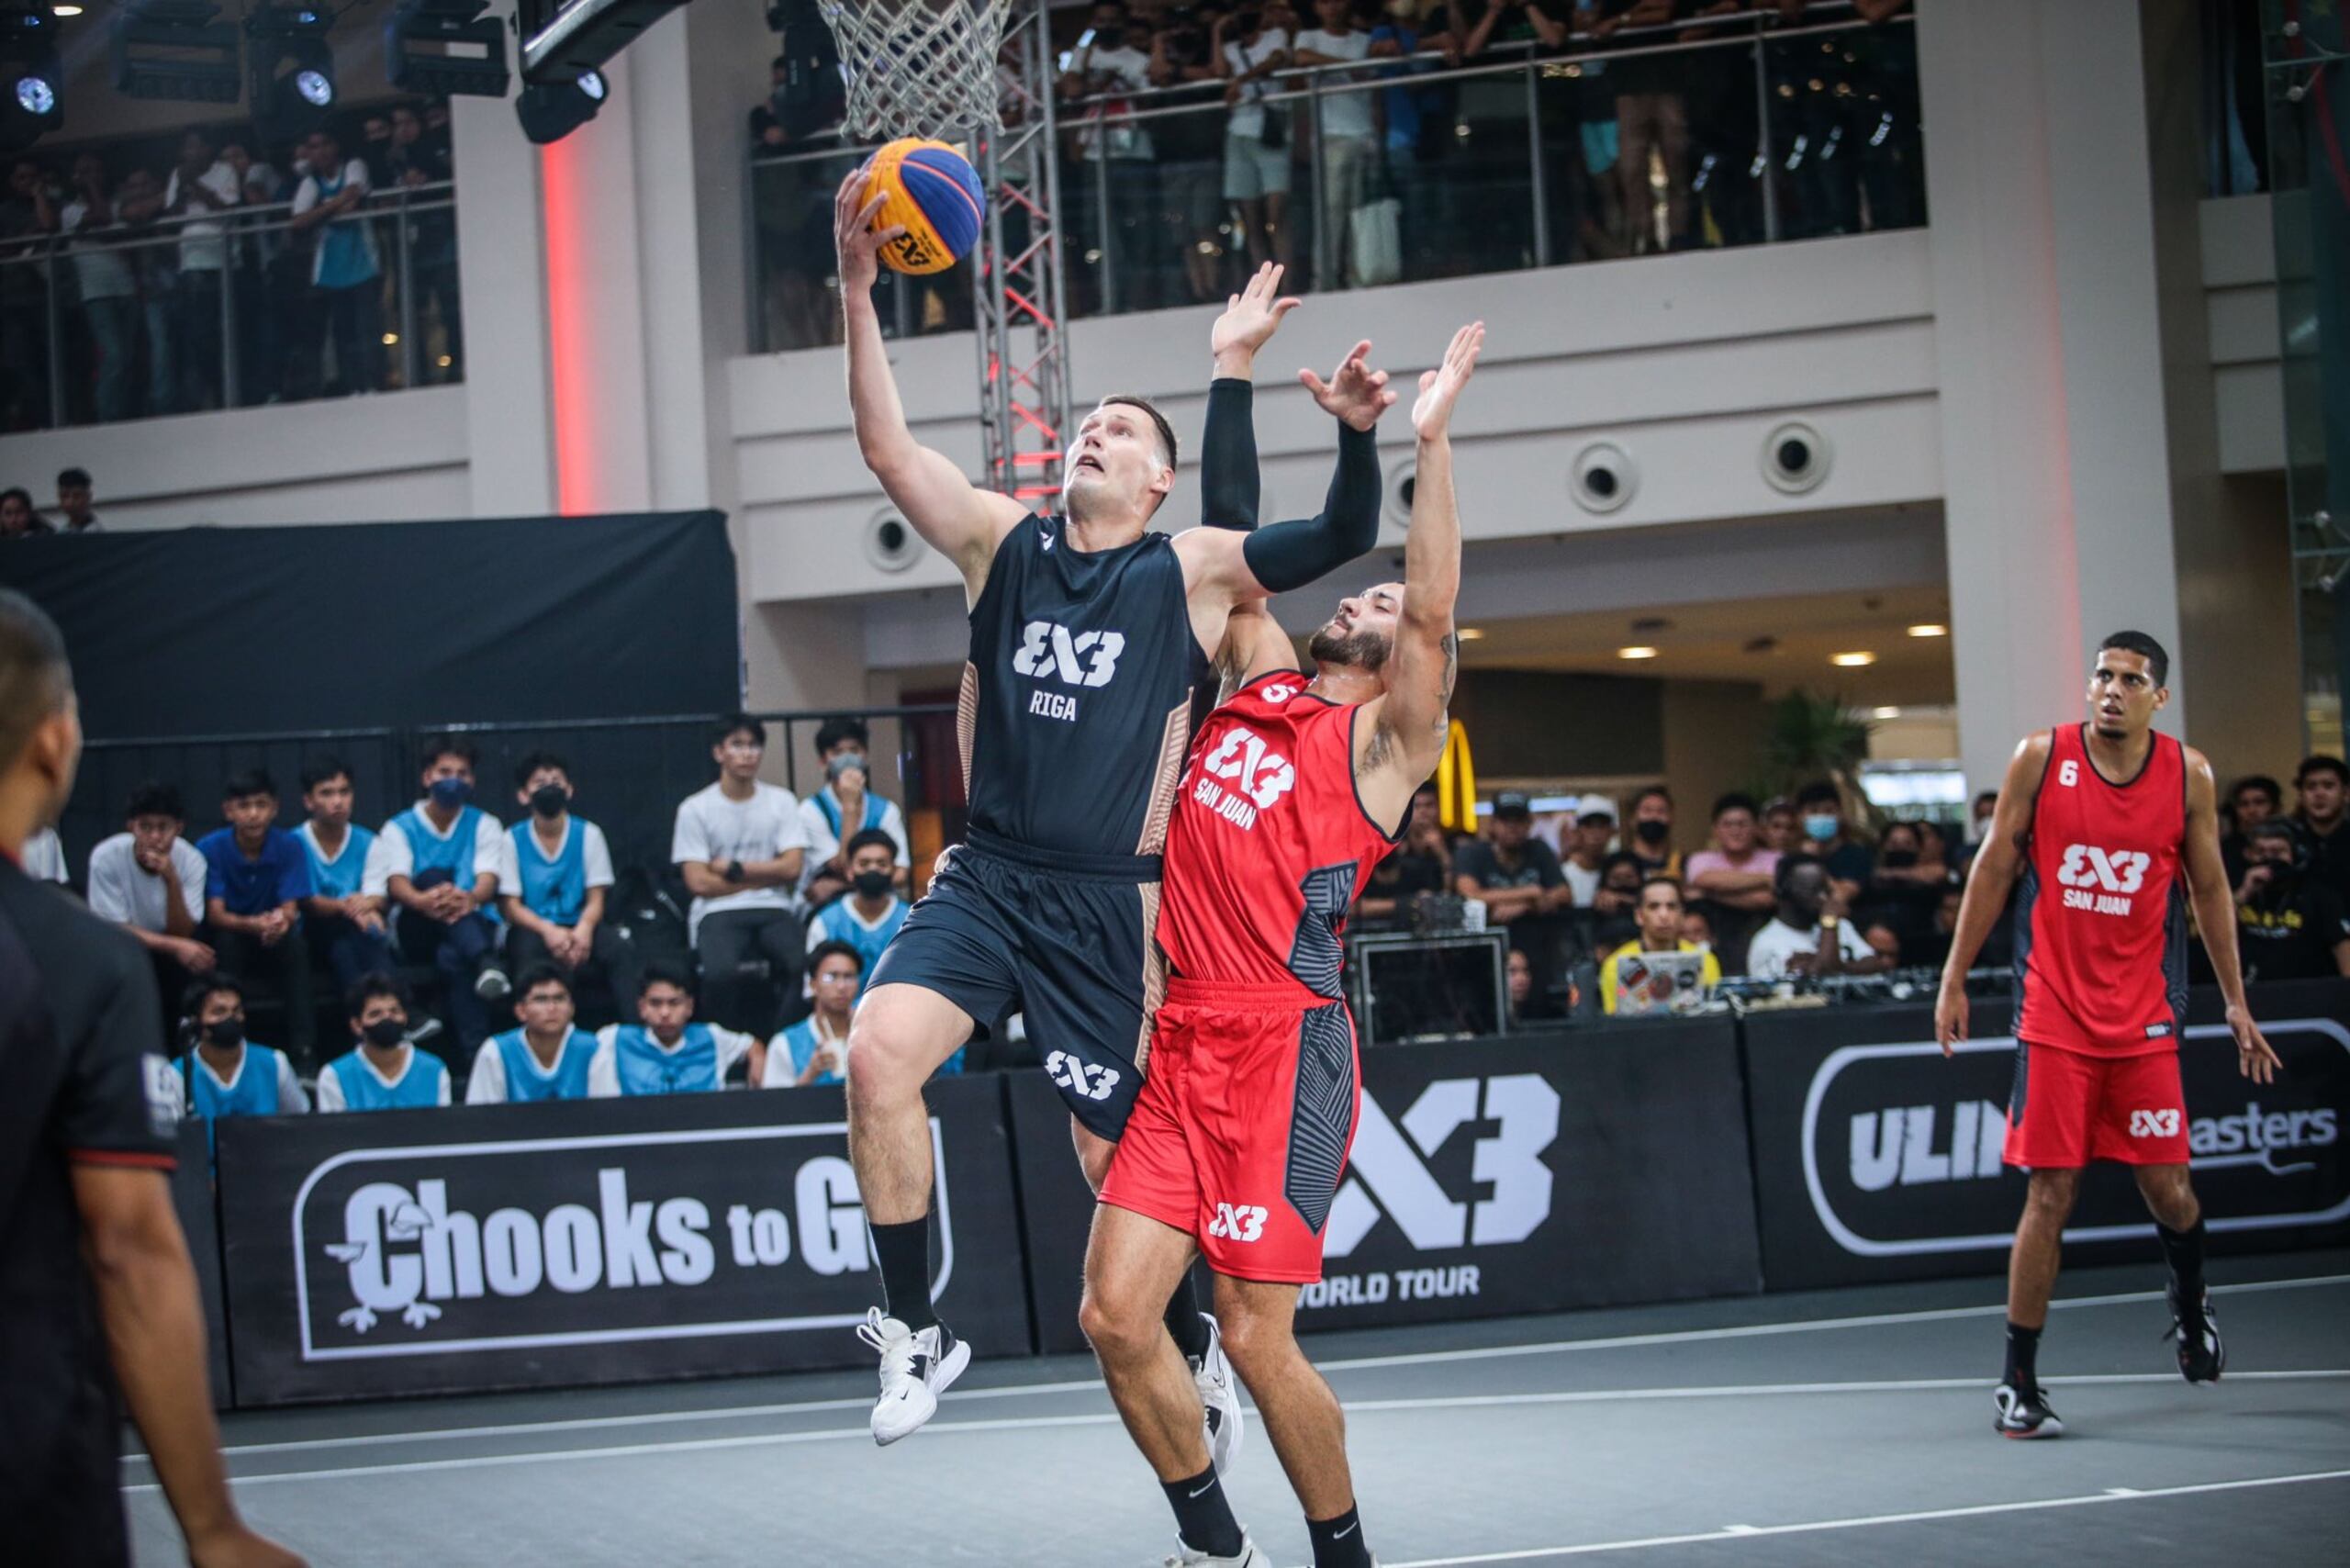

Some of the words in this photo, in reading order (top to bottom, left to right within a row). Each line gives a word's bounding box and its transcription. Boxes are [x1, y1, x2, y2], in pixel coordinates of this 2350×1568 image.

[1029, 689, 1076, 722] RIGA
[2059, 759, 2079, 787] 6
[1193, 778, 1224, 809] SAN
[1214, 793, 1257, 831] JUAN
[2062, 888, 2094, 911] SAN
[2093, 894, 2132, 916] JUAN
[341, 1166, 716, 1314] Chooks
[726, 1204, 791, 1267] to
[794, 1155, 881, 1276] G
[1394, 1264, 1481, 1301] TOUR
